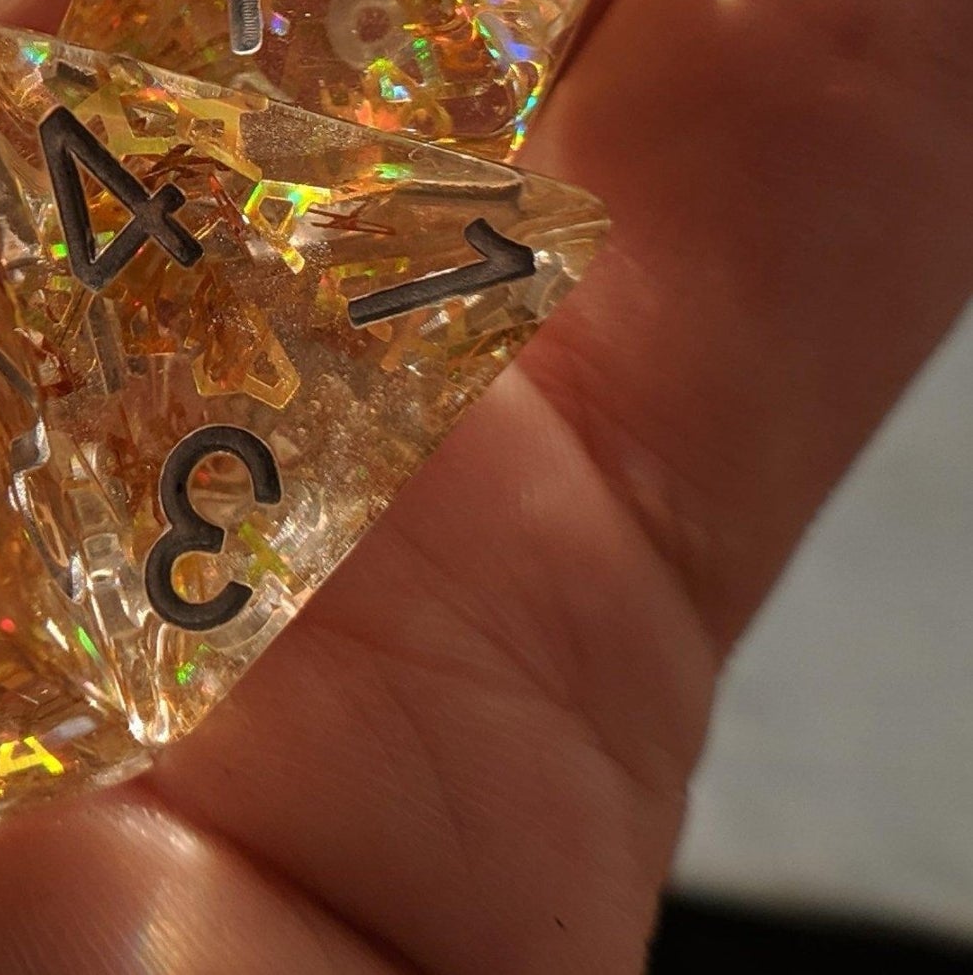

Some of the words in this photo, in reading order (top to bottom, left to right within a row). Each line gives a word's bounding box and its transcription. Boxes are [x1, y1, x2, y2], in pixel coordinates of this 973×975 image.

[39, 104, 205, 293] 4
[347, 218, 536, 329] 1
[144, 424, 283, 631] 3
